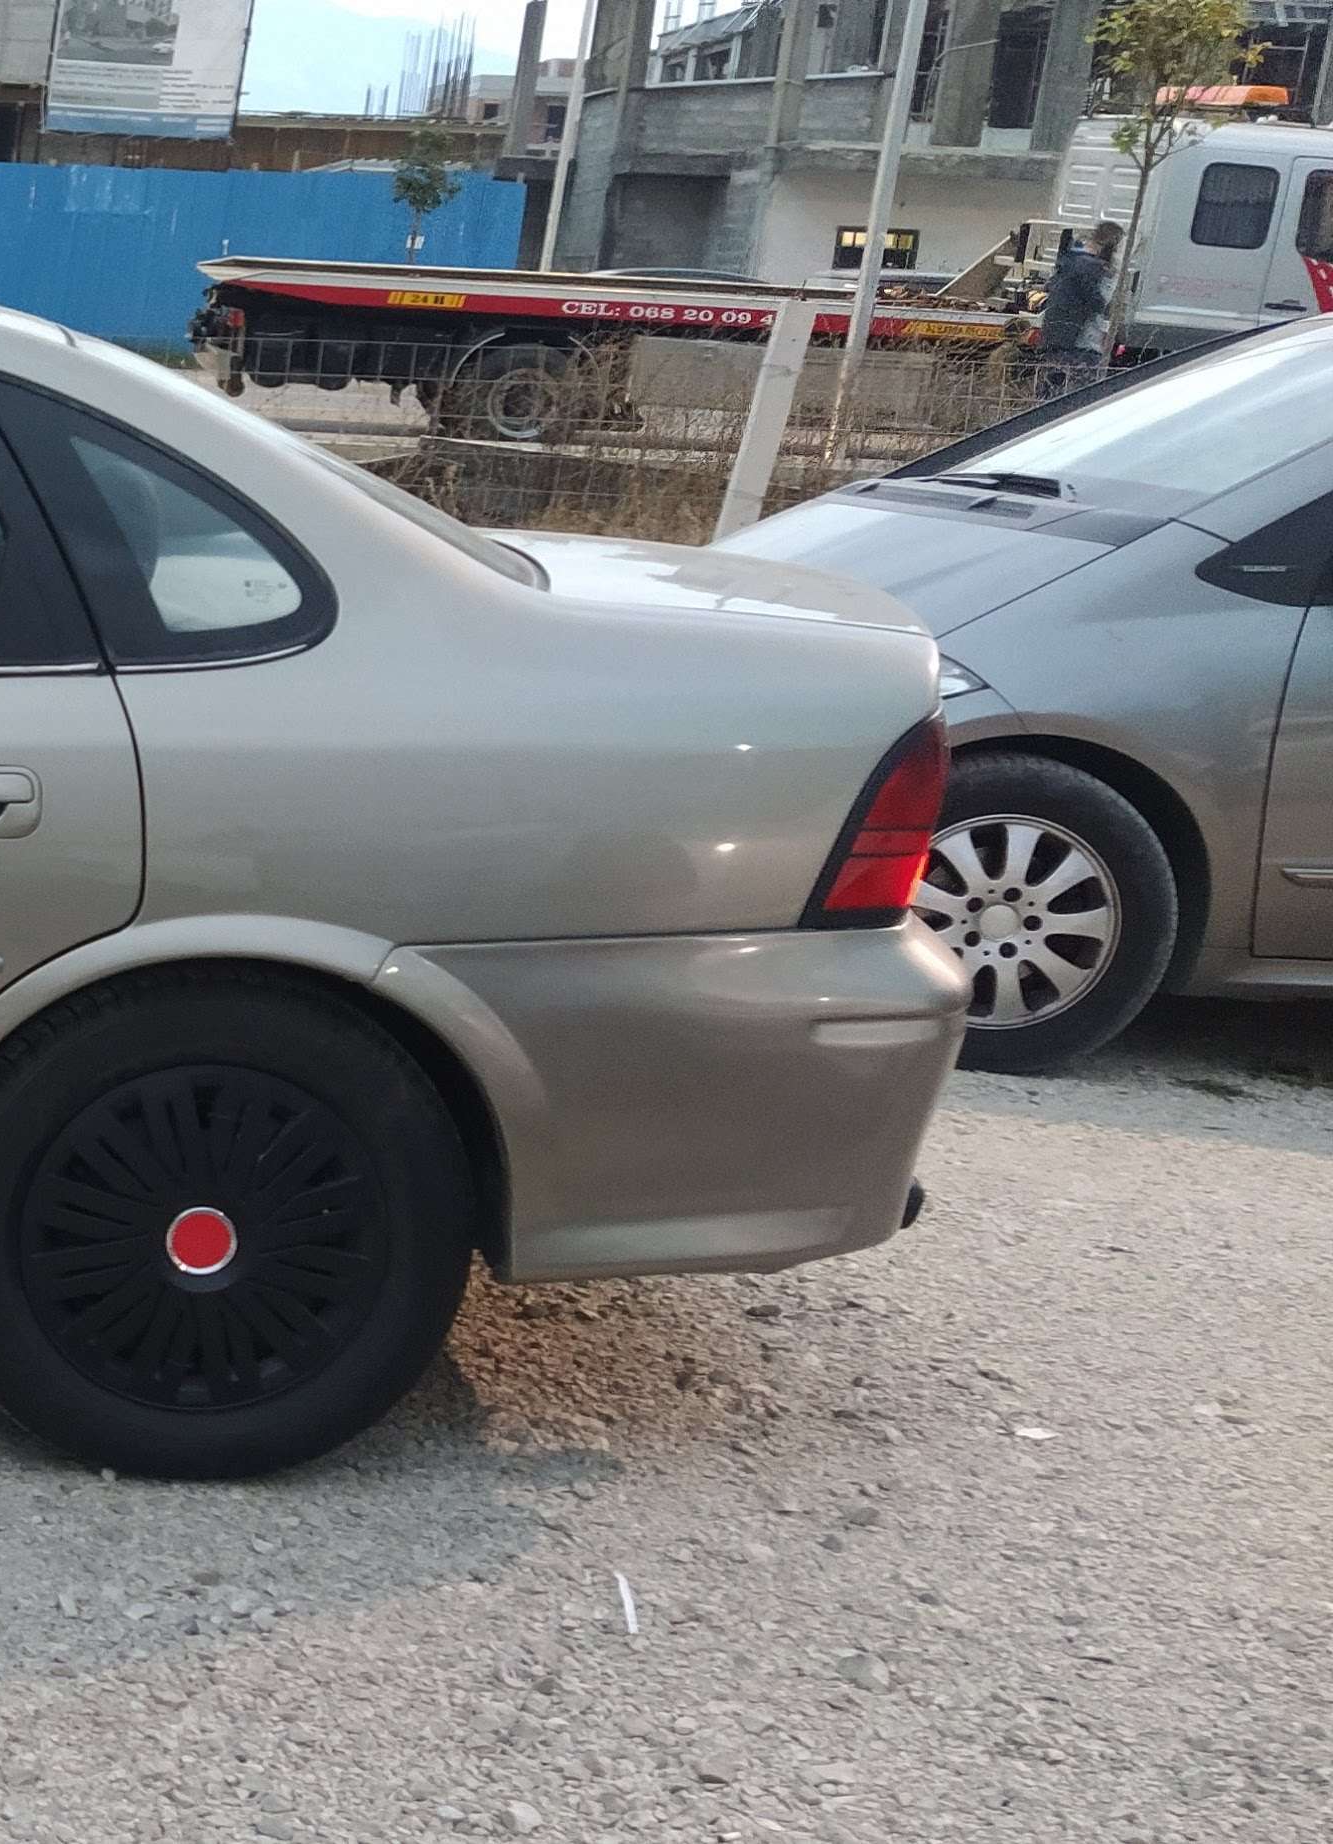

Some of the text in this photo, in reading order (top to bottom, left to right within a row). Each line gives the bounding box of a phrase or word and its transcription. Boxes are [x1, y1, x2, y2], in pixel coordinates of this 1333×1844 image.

[410, 294, 445, 305] 24 H
[561, 301, 621, 317] CEL:
[629, 305, 676, 320] 068
[682, 309, 714, 322] 20
[721, 312, 752, 324] 09
